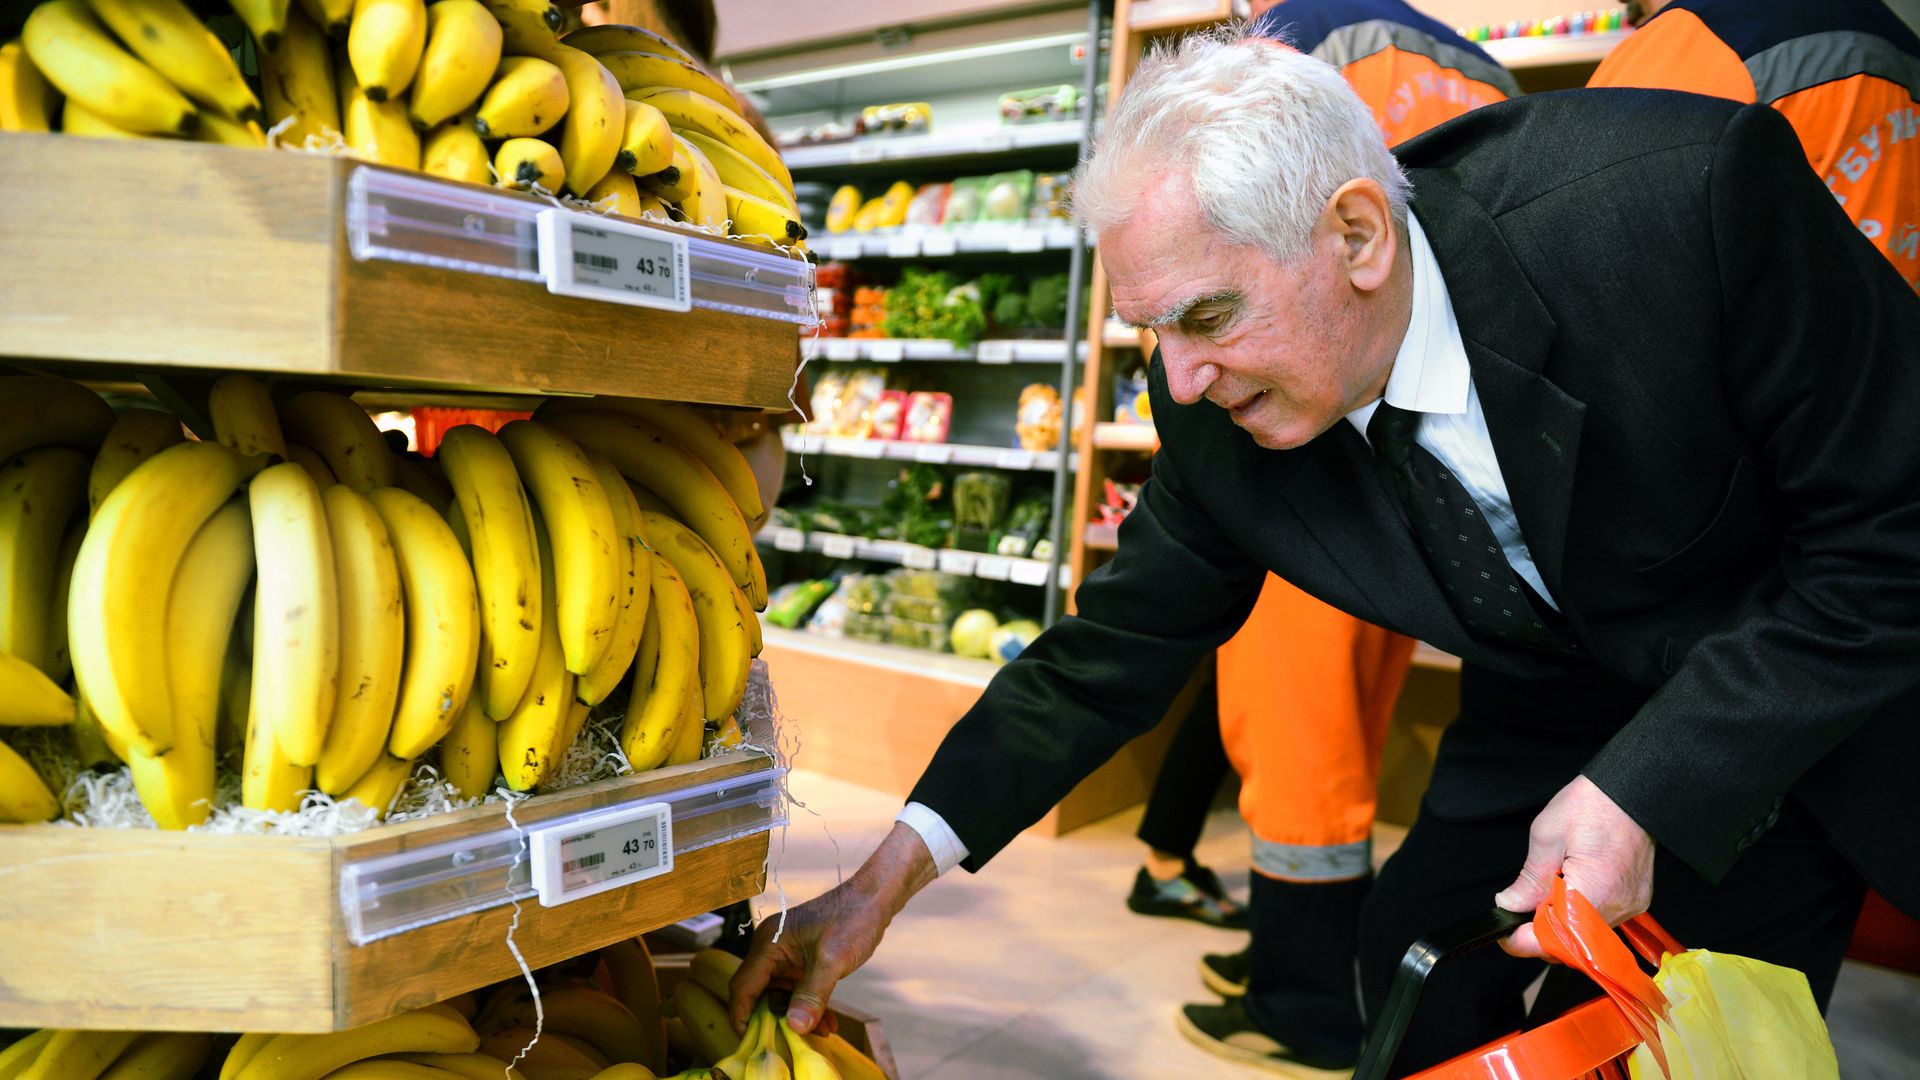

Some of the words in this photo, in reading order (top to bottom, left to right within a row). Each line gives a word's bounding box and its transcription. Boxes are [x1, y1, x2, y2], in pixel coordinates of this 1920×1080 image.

[637, 257, 655, 275] 43
[658, 266, 671, 278] 70
[622, 838, 639, 855] 43
[643, 839, 655, 850] 70
